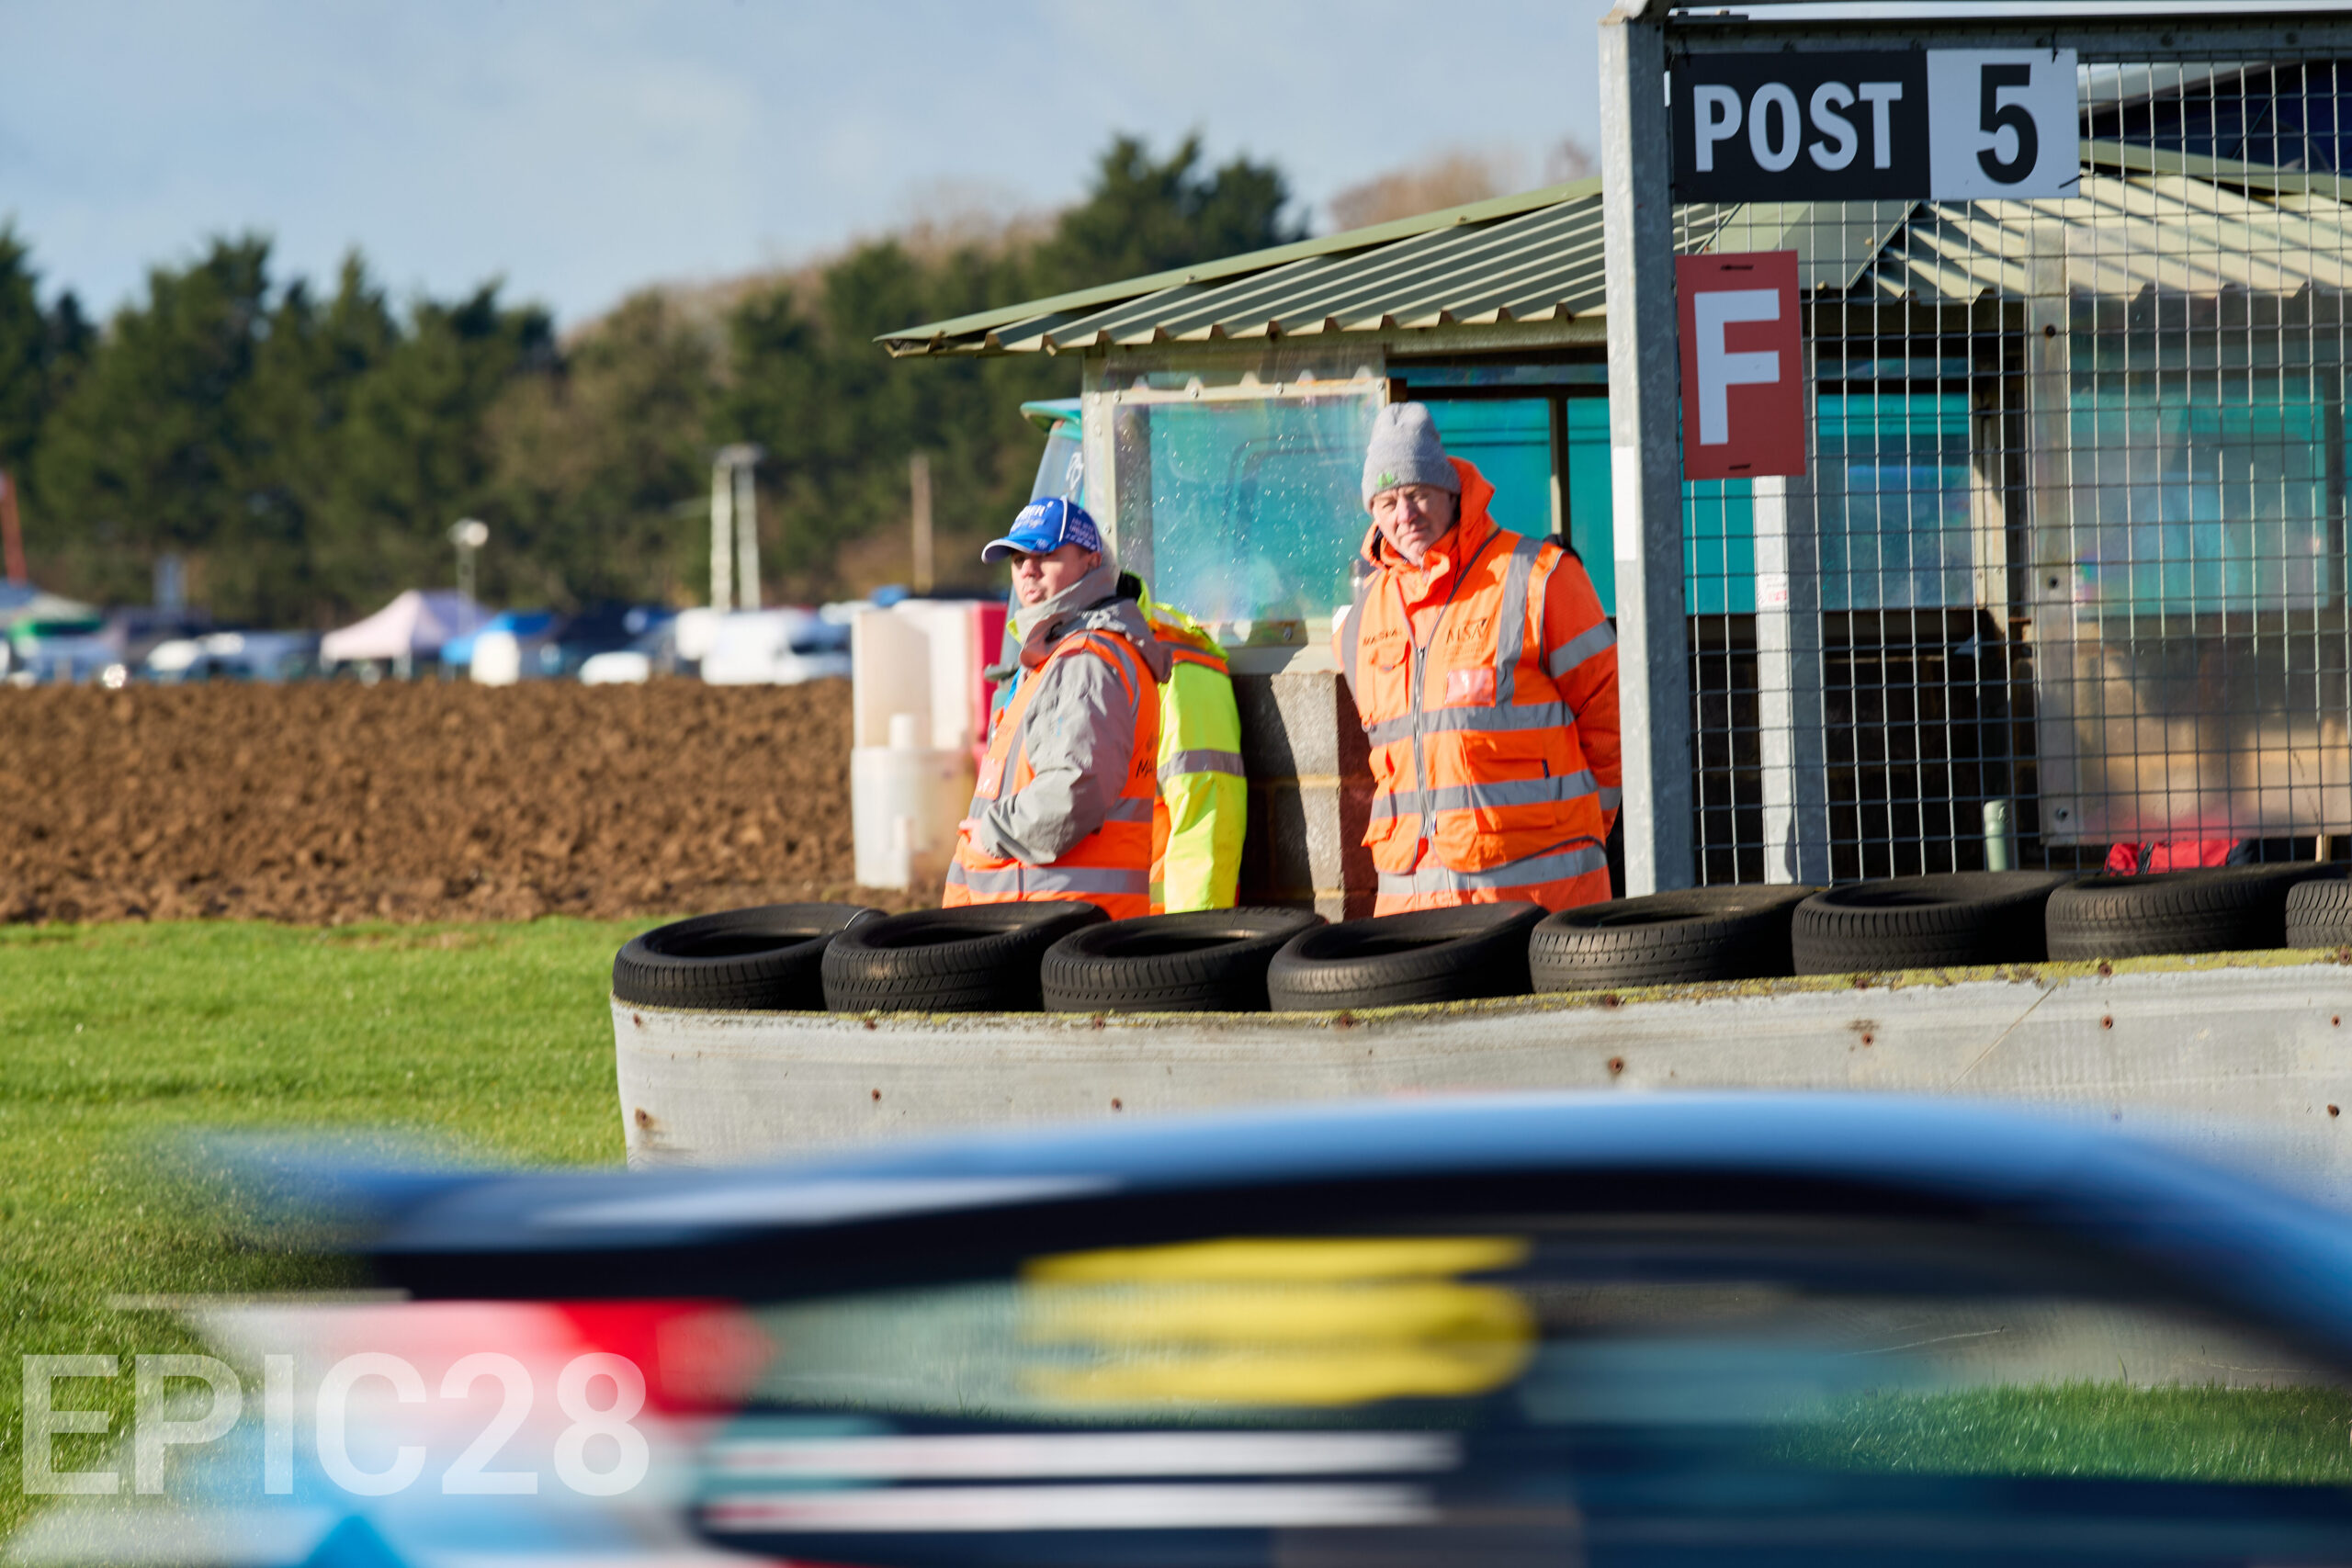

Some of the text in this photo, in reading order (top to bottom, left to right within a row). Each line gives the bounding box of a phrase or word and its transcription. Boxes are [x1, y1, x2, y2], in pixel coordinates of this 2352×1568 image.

[1692, 62, 2039, 185] POST 5
[1694, 288, 1780, 446] F
